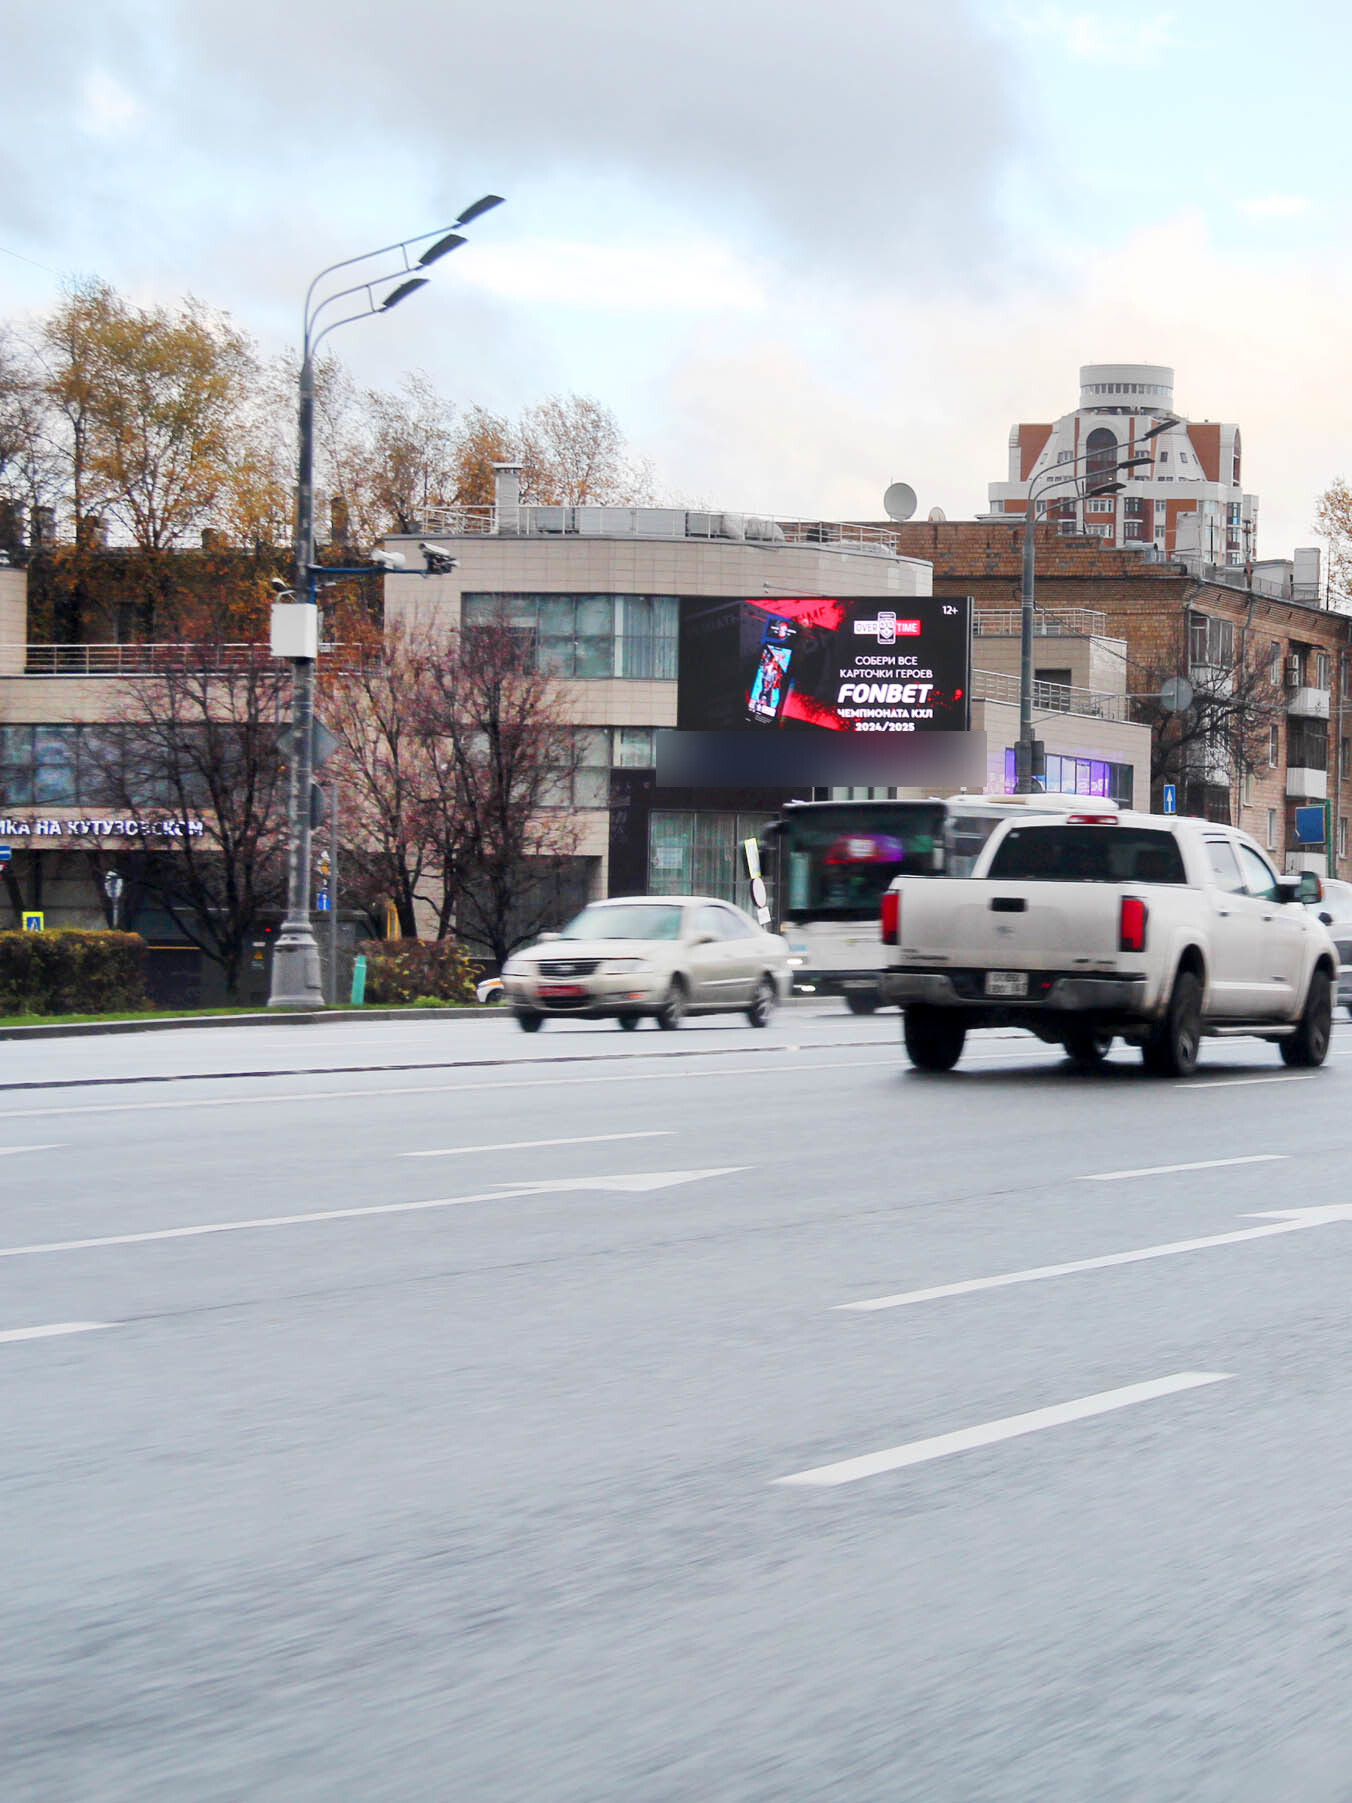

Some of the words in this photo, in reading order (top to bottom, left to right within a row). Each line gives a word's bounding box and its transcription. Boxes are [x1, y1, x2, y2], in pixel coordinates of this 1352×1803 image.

[942, 605, 959, 615] 12+
[897, 623, 918, 633] TIME
[855, 656, 896, 666] СОБЕРИ
[898, 656, 918, 666] ВСЕ
[840, 669, 893, 678] КАРТОЧКИ
[896, 669, 933, 678] ГЕРОЕВ
[838, 684, 934, 703] FONBET
[837, 709, 909, 718] ЧЕМПИОНАТА
[911, 709, 933, 718] КХЛ
[855, 721, 915, 731] 2024/2025
[37, 820, 62, 835] НА
